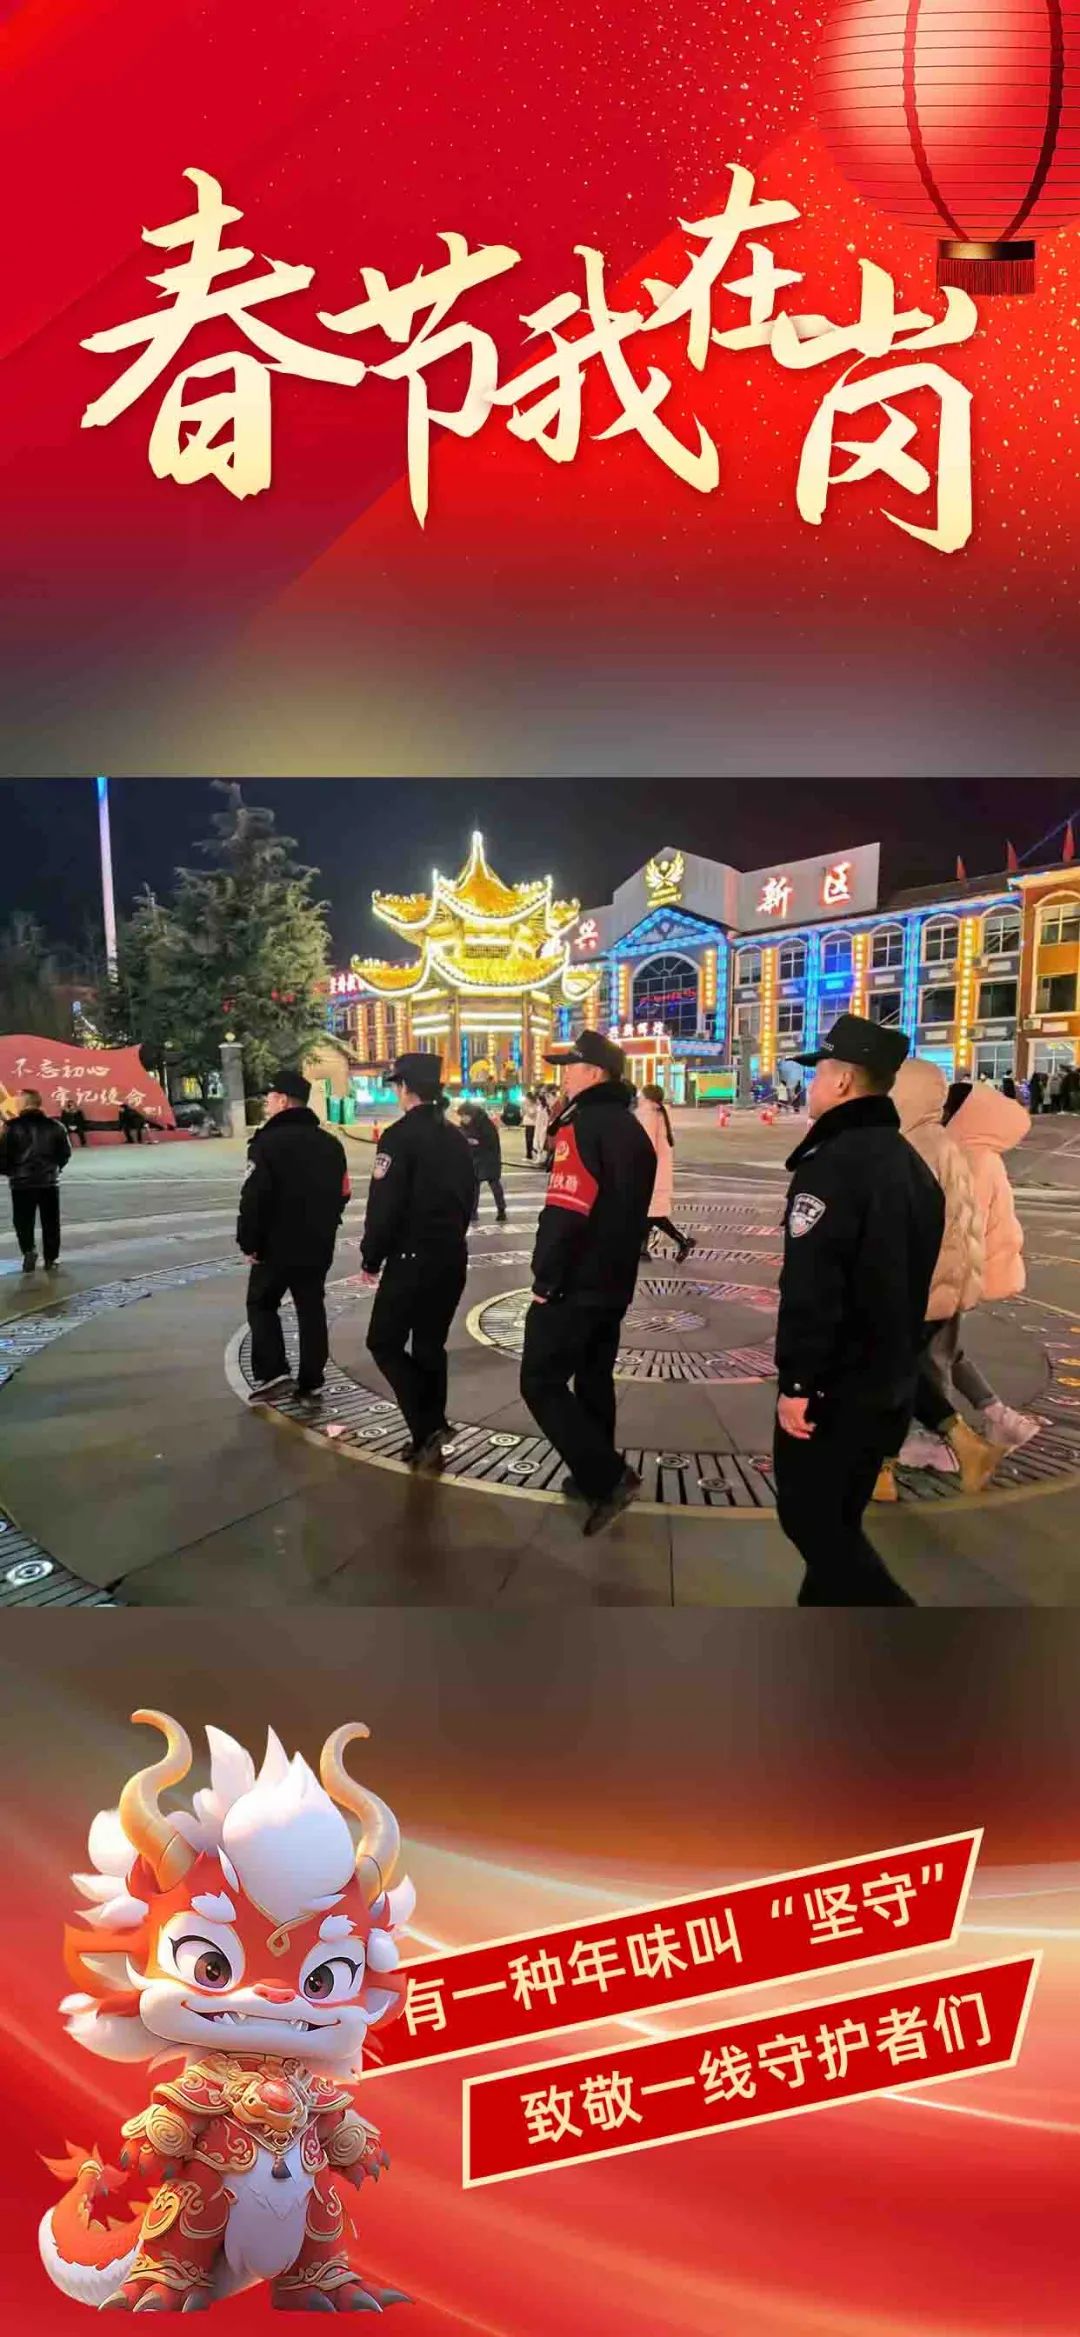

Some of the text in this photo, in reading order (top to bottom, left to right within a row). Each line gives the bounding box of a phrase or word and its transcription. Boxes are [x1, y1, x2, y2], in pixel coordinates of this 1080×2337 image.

[756, 862, 851, 918] 新区
[11, 1057, 111, 1078] 不忘初心
[51, 1085, 146, 1107] 牢记使命
[548, 1171, 578, 1193] 执勤
